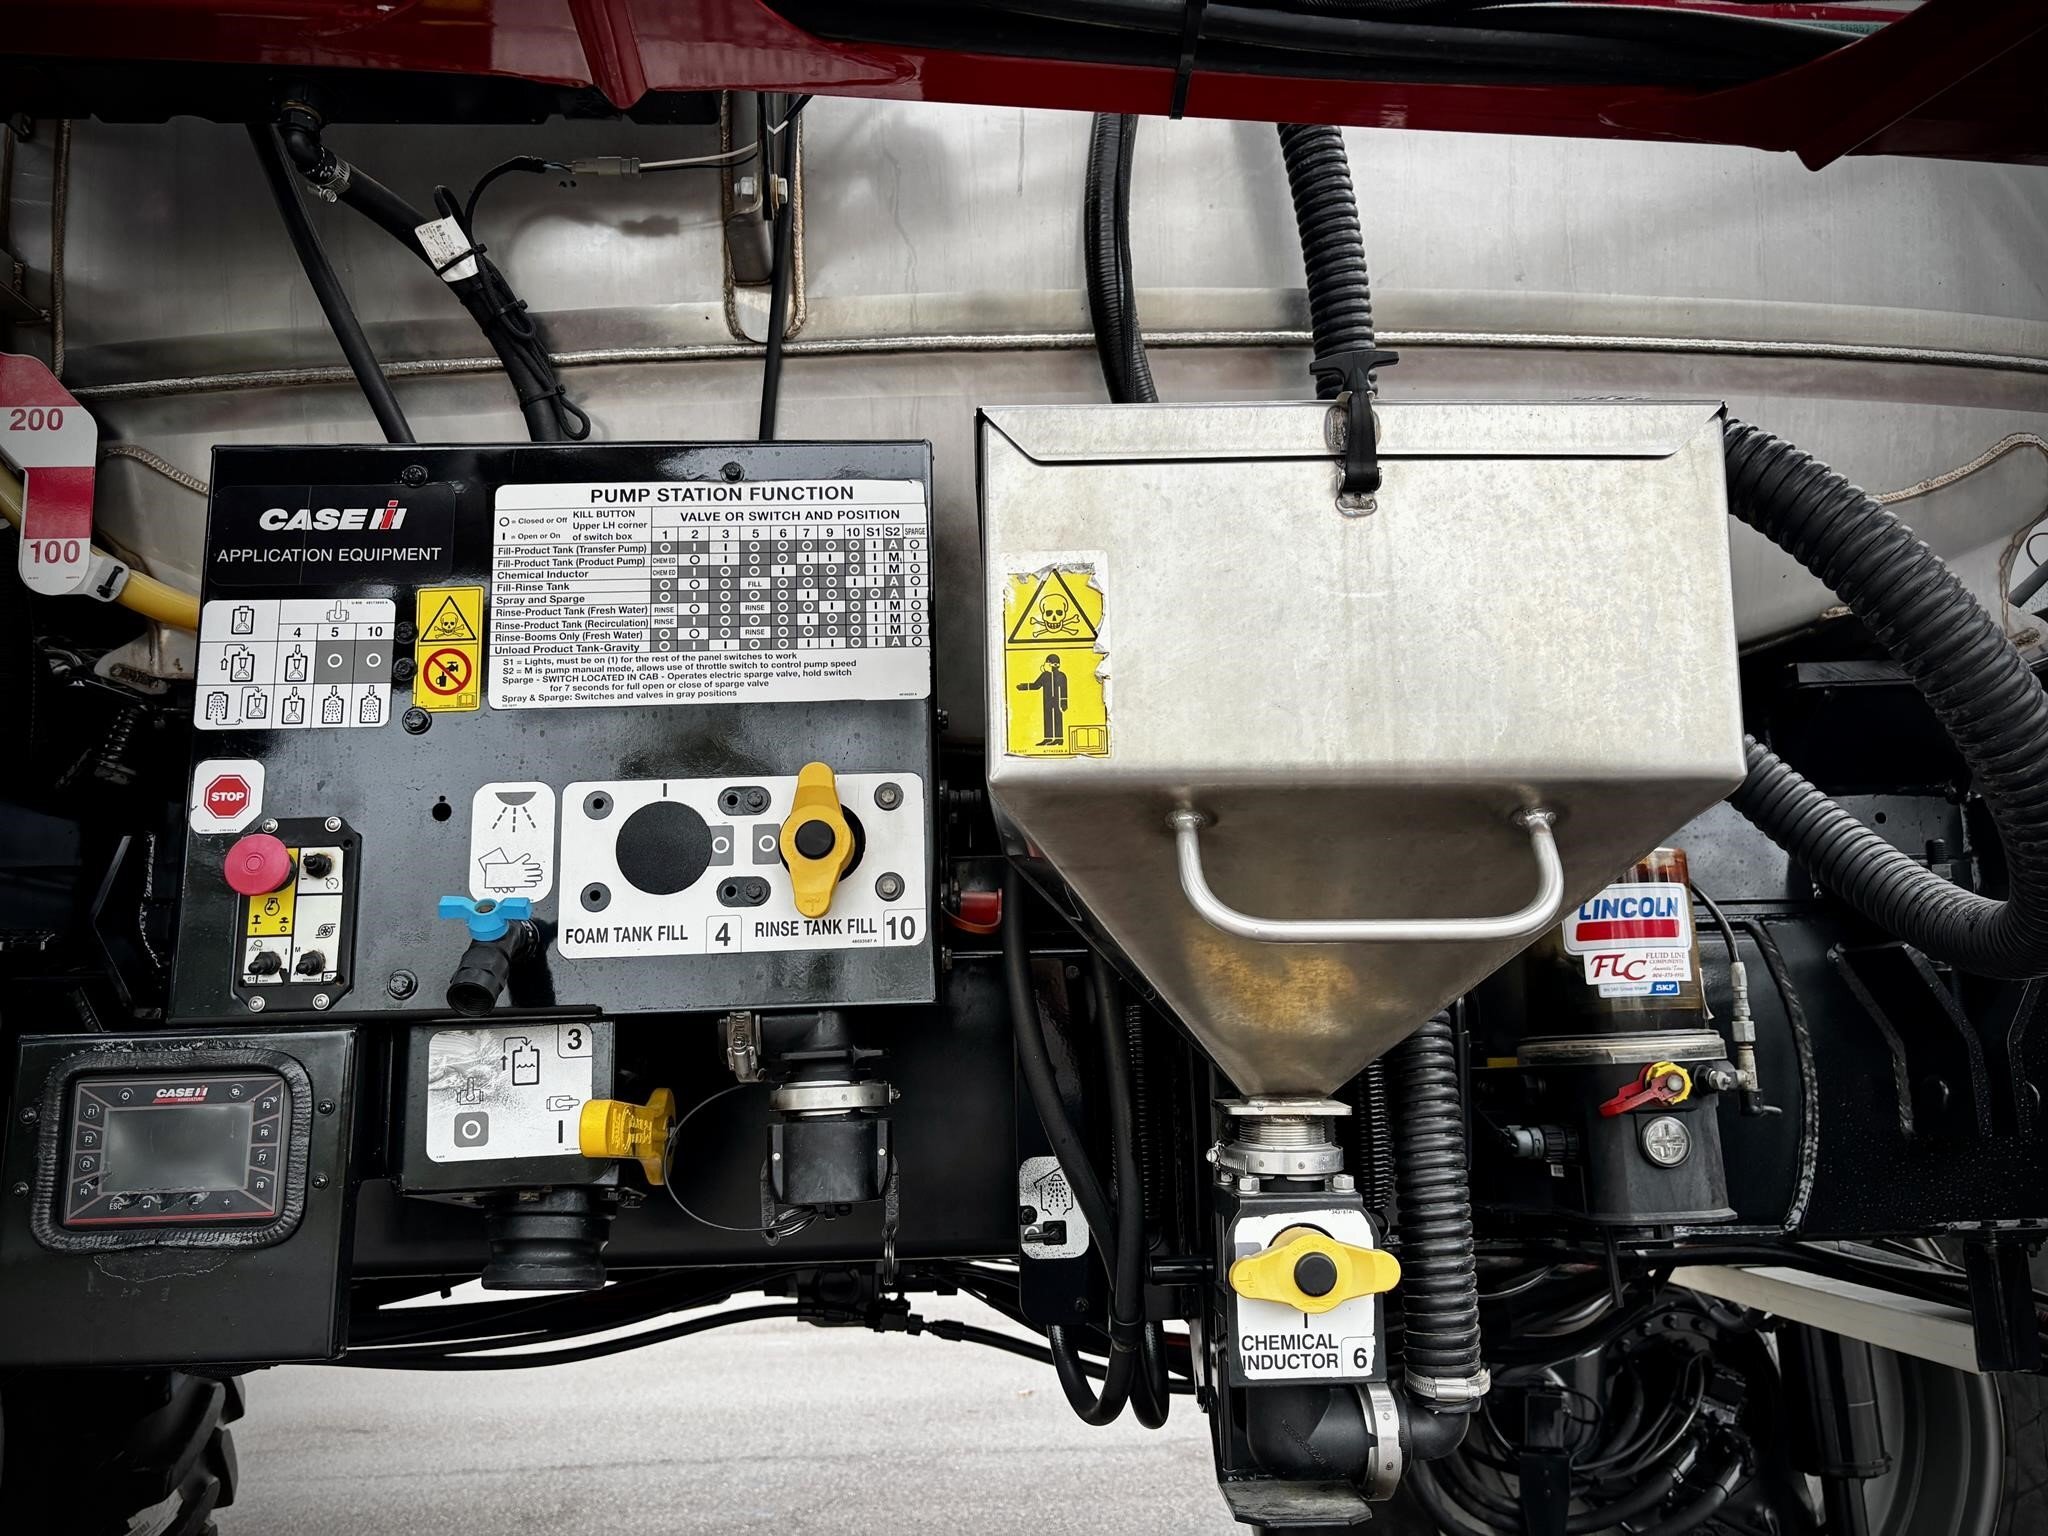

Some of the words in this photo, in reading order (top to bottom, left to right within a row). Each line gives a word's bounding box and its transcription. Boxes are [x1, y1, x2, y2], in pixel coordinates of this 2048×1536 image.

[9, 408, 64, 431] 200
[591, 489, 650, 503] PUMP
[657, 487, 741, 502] STATION
[750, 486, 853, 501] FUNCTION
[259, 508, 366, 531] CASE
[573, 510, 594, 519] KILL
[596, 509, 635, 518] BUTTON
[680, 512, 720, 522] VALVE
[725, 512, 744, 521] OR
[748, 511, 800, 521] SWITCH
[805, 511, 833, 520] AND
[837, 510, 900, 520] POSITION
[573, 522, 600, 531] Upper
[602, 521, 615, 529] LH
[572, 532, 582, 541] of
[583, 532, 613, 541] switch
[615, 532, 632, 540] box
[662, 531, 667, 539] 1
[691, 530, 699, 539] 2
[722, 529, 730, 538] 3
[752, 529, 759, 538] 5
[780, 529, 787, 538] 6
[803, 528, 810, 538] 7
[826, 528, 834, 537] 9
[846, 528, 860, 537] 10
[866, 527, 880, 537] S1
[885, 527, 900, 536] S2
[905, 527, 925, 536] SPARGE
[30, 540, 81, 564] 100
[217, 548, 333, 563] APPLICATION
[338, 547, 442, 562] EQUIPMENT
[497, 546, 550, 555] Fill-Product
[553, 545, 574, 554] Tank
[576, 545, 616, 555] (Transfer
[617, 544, 647, 554] Pump)
[497, 559, 550, 568] Fill-Product
[552, 558, 573, 567] Tank
[576, 557, 614, 567] (Product
[616, 556, 646, 567] Pump)
[497, 570, 544, 580] Chemical
[546, 570, 589, 578] Inductor
[497, 582, 543, 592] Fill-Rinse
[546, 582, 570, 591] Tank
[496, 596, 526, 606] Spray
[528, 596, 547, 604] and
[549, 595, 585, 604] Sparge
[495, 608, 561, 617] Rinse-Product
[564, 607, 585, 616] Tank
[587, 606, 616, 617] (Fresh
[618, 605, 648, 615] Water)
[495, 620, 559, 630] Rinse-Product
[561, 620, 583, 629] Tank
[585, 618, 649, 630] (Recirculation)
[293, 627, 301, 638] 4
[330, 626, 339, 638] 5
[367, 625, 383, 637] 10
[495, 633, 557, 642] Rinse-Booms
[559, 632, 580, 642] Only
[582, 631, 611, 642] (Fresh
[613, 631, 643, 641] Water)
[494, 645, 531, 655] Unload
[533, 645, 574, 654] Product
[576, 643, 640, 653] Tank-Gravity
[503, 658, 514, 666] S1
[524, 658, 554, 666] Lights,
[556, 657, 578, 665] must
[580, 656, 592, 664] be
[607, 656, 618, 665] (1)
[635, 655, 650, 663] the
[670, 654, 680, 662] of
[698, 653, 722, 663] panel
[724, 652, 762, 660] switches
[775, 652, 797, 660] work
[502, 667, 514, 675] S2
[535, 666, 542, 674] is
[545, 667, 570, 676] pump
[572, 665, 604, 673] manual
[606, 665, 634, 674] mode,
[636, 664, 665, 672] allows
[696, 662, 727, 670] throttle
[771, 661, 801, 669] control
[803, 661, 828, 669] pump
[830, 659, 857, 668] speed
[502, 676, 534, 685] Sparge
[542, 675, 579, 683] SWITCH
[581, 674, 625, 682] LOCATED
[627, 673, 637, 681] IN
[667, 672, 707, 681] Operates
[709, 671, 741, 679] electric
[744, 670, 774, 679] sparge
[776, 670, 801, 678] valve,
[802, 669, 822, 677] hold
[824, 669, 852, 677] switch
[501, 695, 527, 703] Spray
[529, 694, 536, 702] &
[538, 693, 572, 702] Sparge:
[574, 692, 614, 701] Switches
[636, 691, 664, 699] valves
[676, 691, 696, 699] gray
[697, 690, 737, 699] positions
[211, 791, 245, 802] STOP
[1579, 896, 1678, 921] LINCOLN
[565, 927, 609, 945] FOAM
[613, 926, 652, 943] TANK
[657, 925, 688, 941] FILL
[715, 922, 731, 947] 4
[755, 920, 799, 939] RINSE
[804, 919, 843, 936] TANK
[847, 918, 878, 934] FILL
[886, 915, 916, 940] 10
[566, 1029, 583, 1051] 3
[155, 1087, 195, 1098] CASE
[262, 1101, 271, 1109] F5
[87, 1108, 96, 1116] F1
[260, 1129, 269, 1137] F6
[84, 1135, 93, 1144] F2
[258, 1153, 267, 1162] F7
[82, 1160, 91, 1169] F3
[256, 1181, 265, 1189] F8
[79, 1187, 89, 1196] F4
[109, 1202, 123, 1211] ESC
[1241, 1333, 1339, 1351] CHEMICAL
[1242, 1353, 1339, 1370] INDUCTOR
[1353, 1347, 1368, 1369] 6
